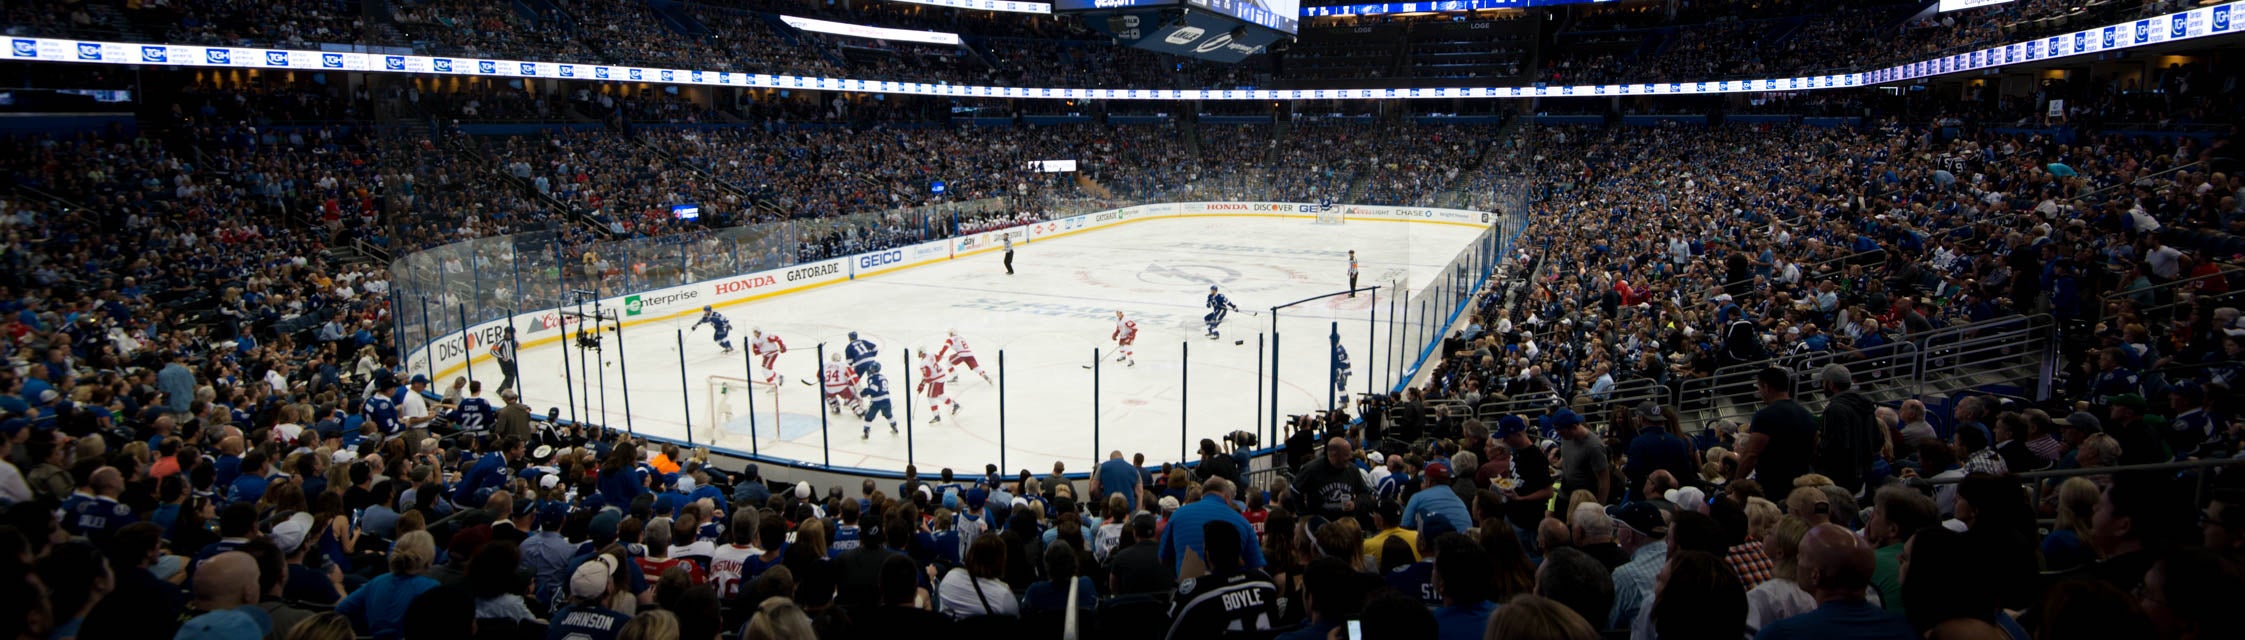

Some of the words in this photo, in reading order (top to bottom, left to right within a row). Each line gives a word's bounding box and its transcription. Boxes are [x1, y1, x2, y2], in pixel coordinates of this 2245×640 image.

[1254, 203, 1293, 211] DISCOVER
[1396, 209, 1424, 217] CHASE
[860, 250, 902, 269] GEICO
[787, 262, 839, 282] GATORADE
[715, 275, 776, 295] HONDA
[626, 289, 698, 313] enterprise
[440, 326, 503, 362] DISCOVER
[854, 344, 868, 355] 11
[825, 369, 839, 382] 34
[461, 412, 484, 431] 22
[1221, 587, 1264, 612] BOYLE
[561, 610, 615, 632] JOHNSON
